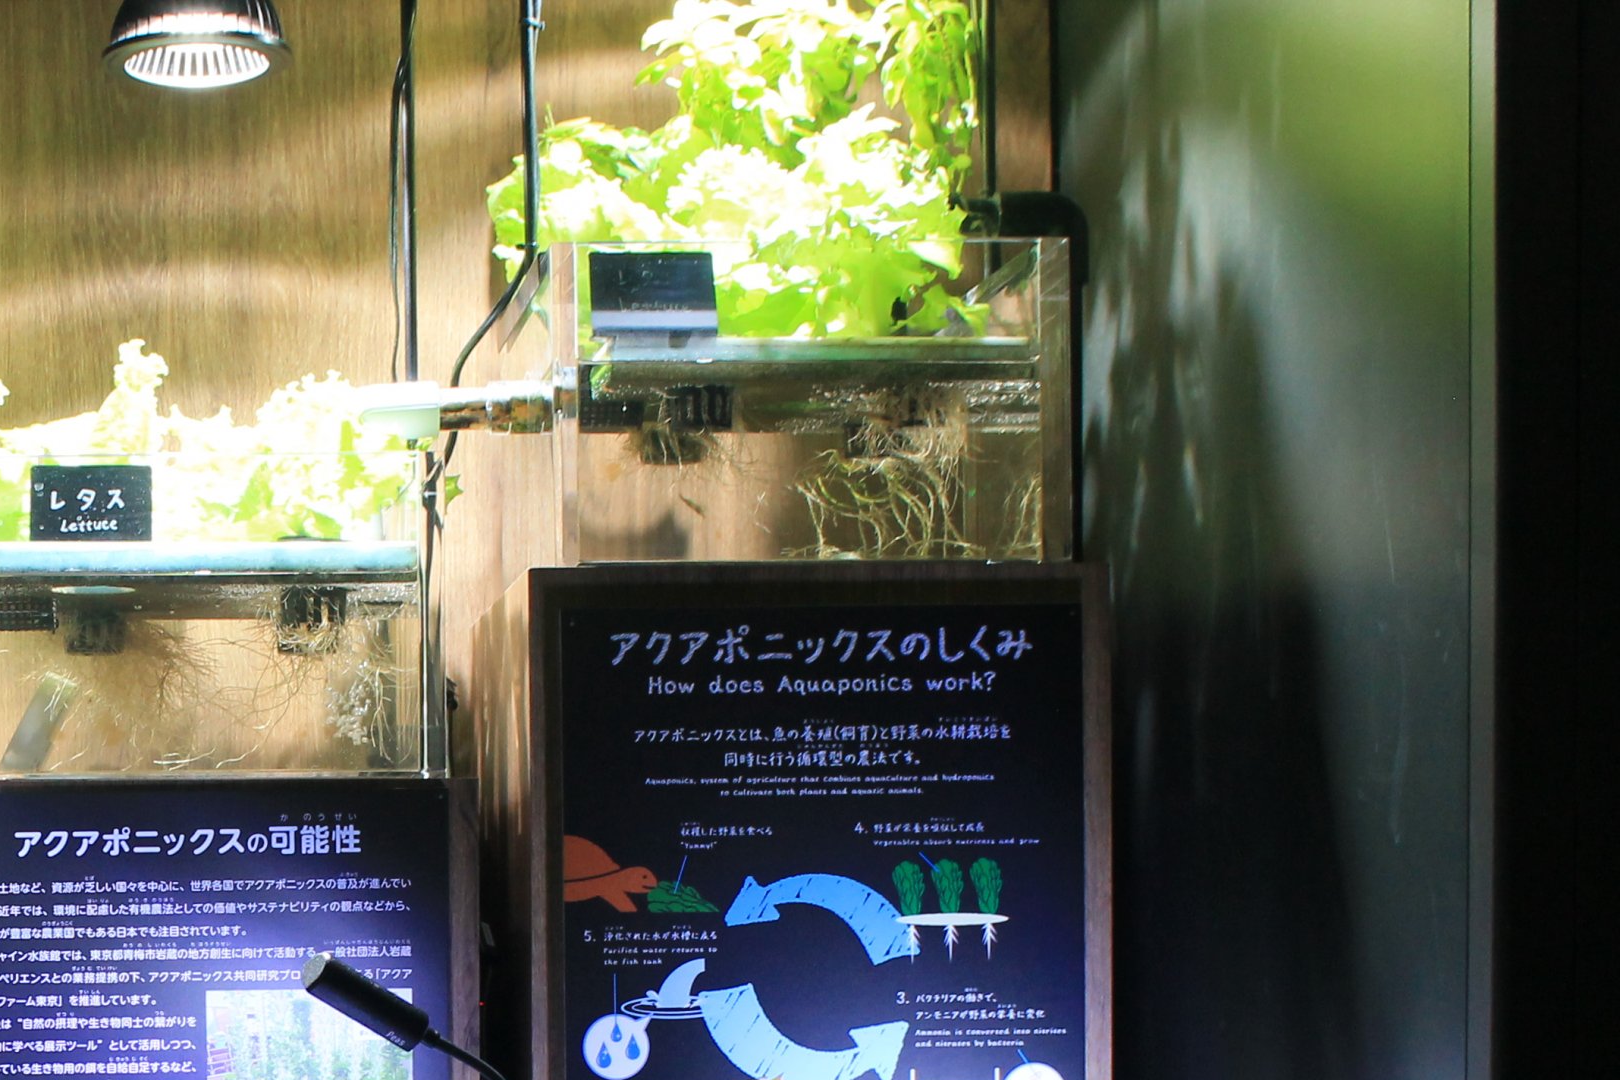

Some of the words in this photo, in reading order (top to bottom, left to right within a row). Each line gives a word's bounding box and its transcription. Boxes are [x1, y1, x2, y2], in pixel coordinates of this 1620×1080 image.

[50, 488, 125, 512] レタス
[60, 519, 118, 533] Lettuce
[610, 624, 1033, 666] アクアポニックスのしくみ
[648, 675, 695, 695] How
[709, 674, 765, 694] does
[777, 673, 913, 696] Aquaponics
[926, 671, 996, 692] work?
[13, 824, 362, 858] アクアポニックスの可能性
